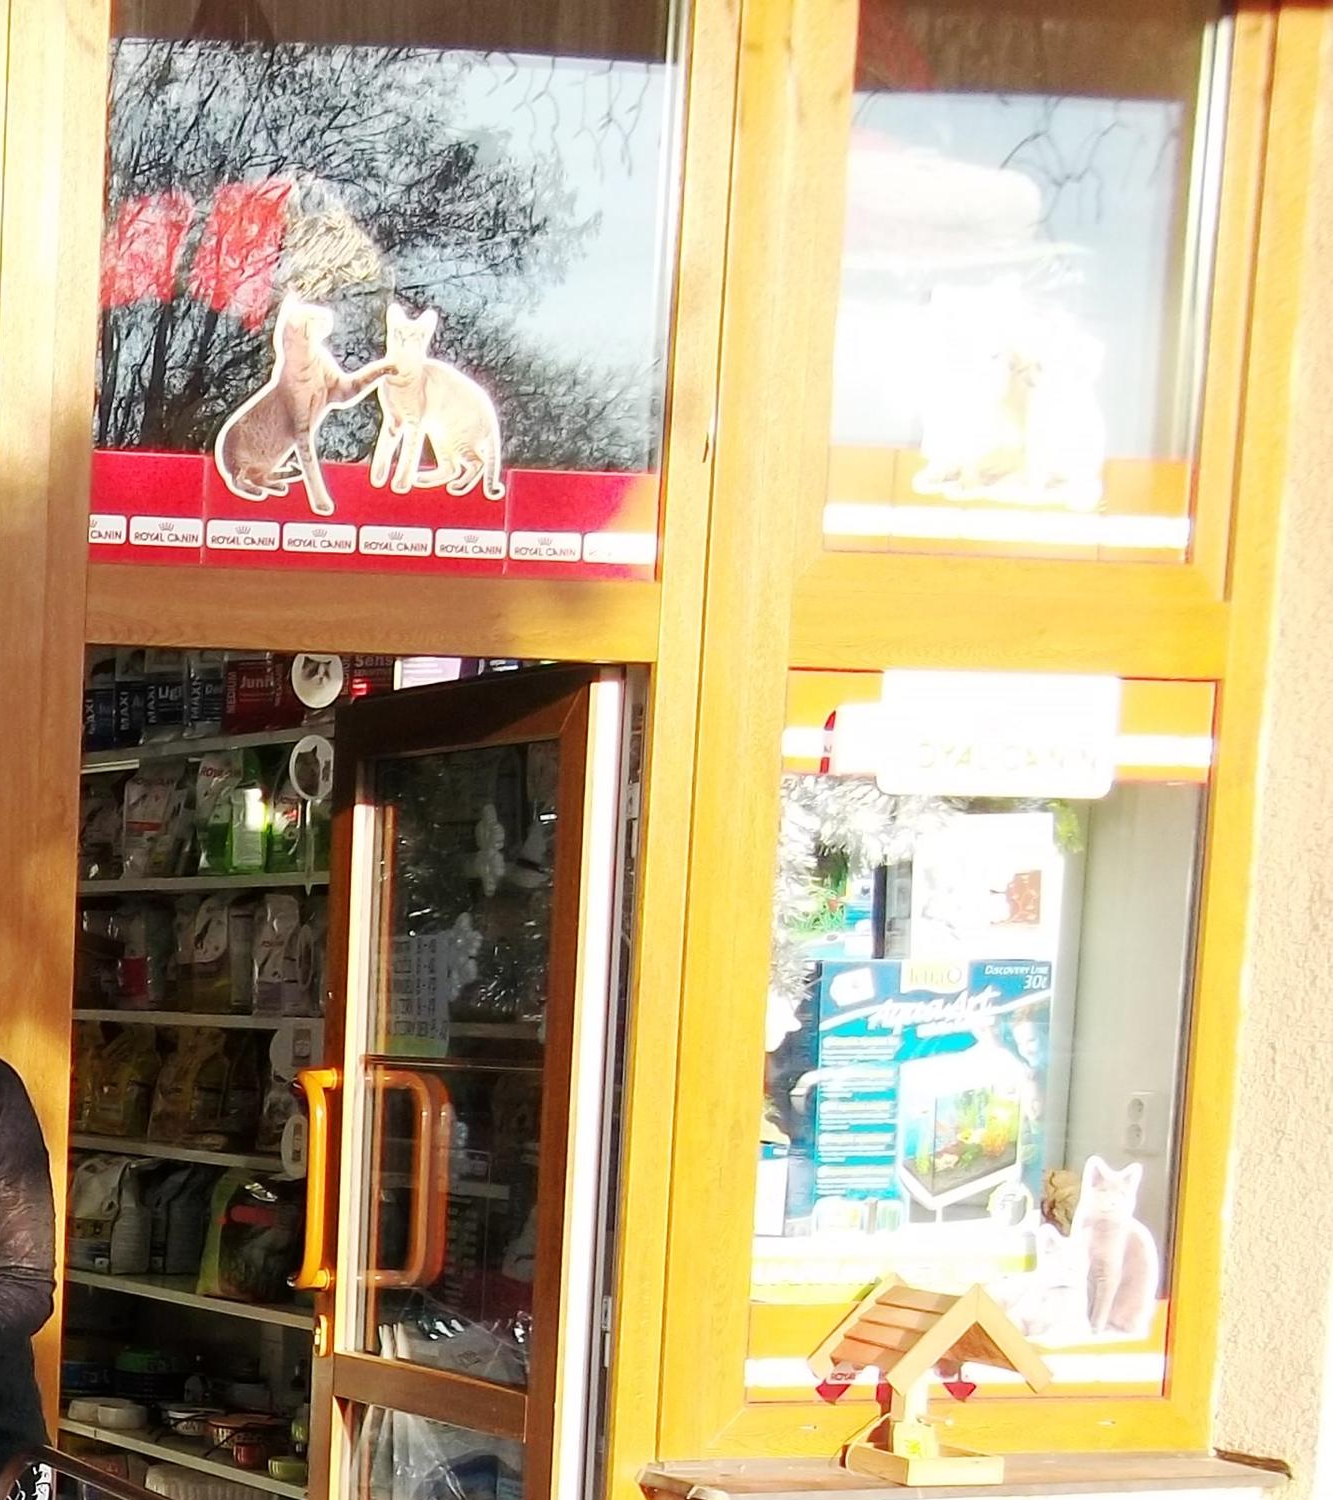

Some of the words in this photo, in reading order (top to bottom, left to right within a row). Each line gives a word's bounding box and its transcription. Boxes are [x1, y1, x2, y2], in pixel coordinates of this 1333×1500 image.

[210, 534, 242, 546] ROYAL
[243, 535, 276, 548] CANIN
[363, 540, 395, 552] ROYAL
[396, 541, 429, 554] CANIN
